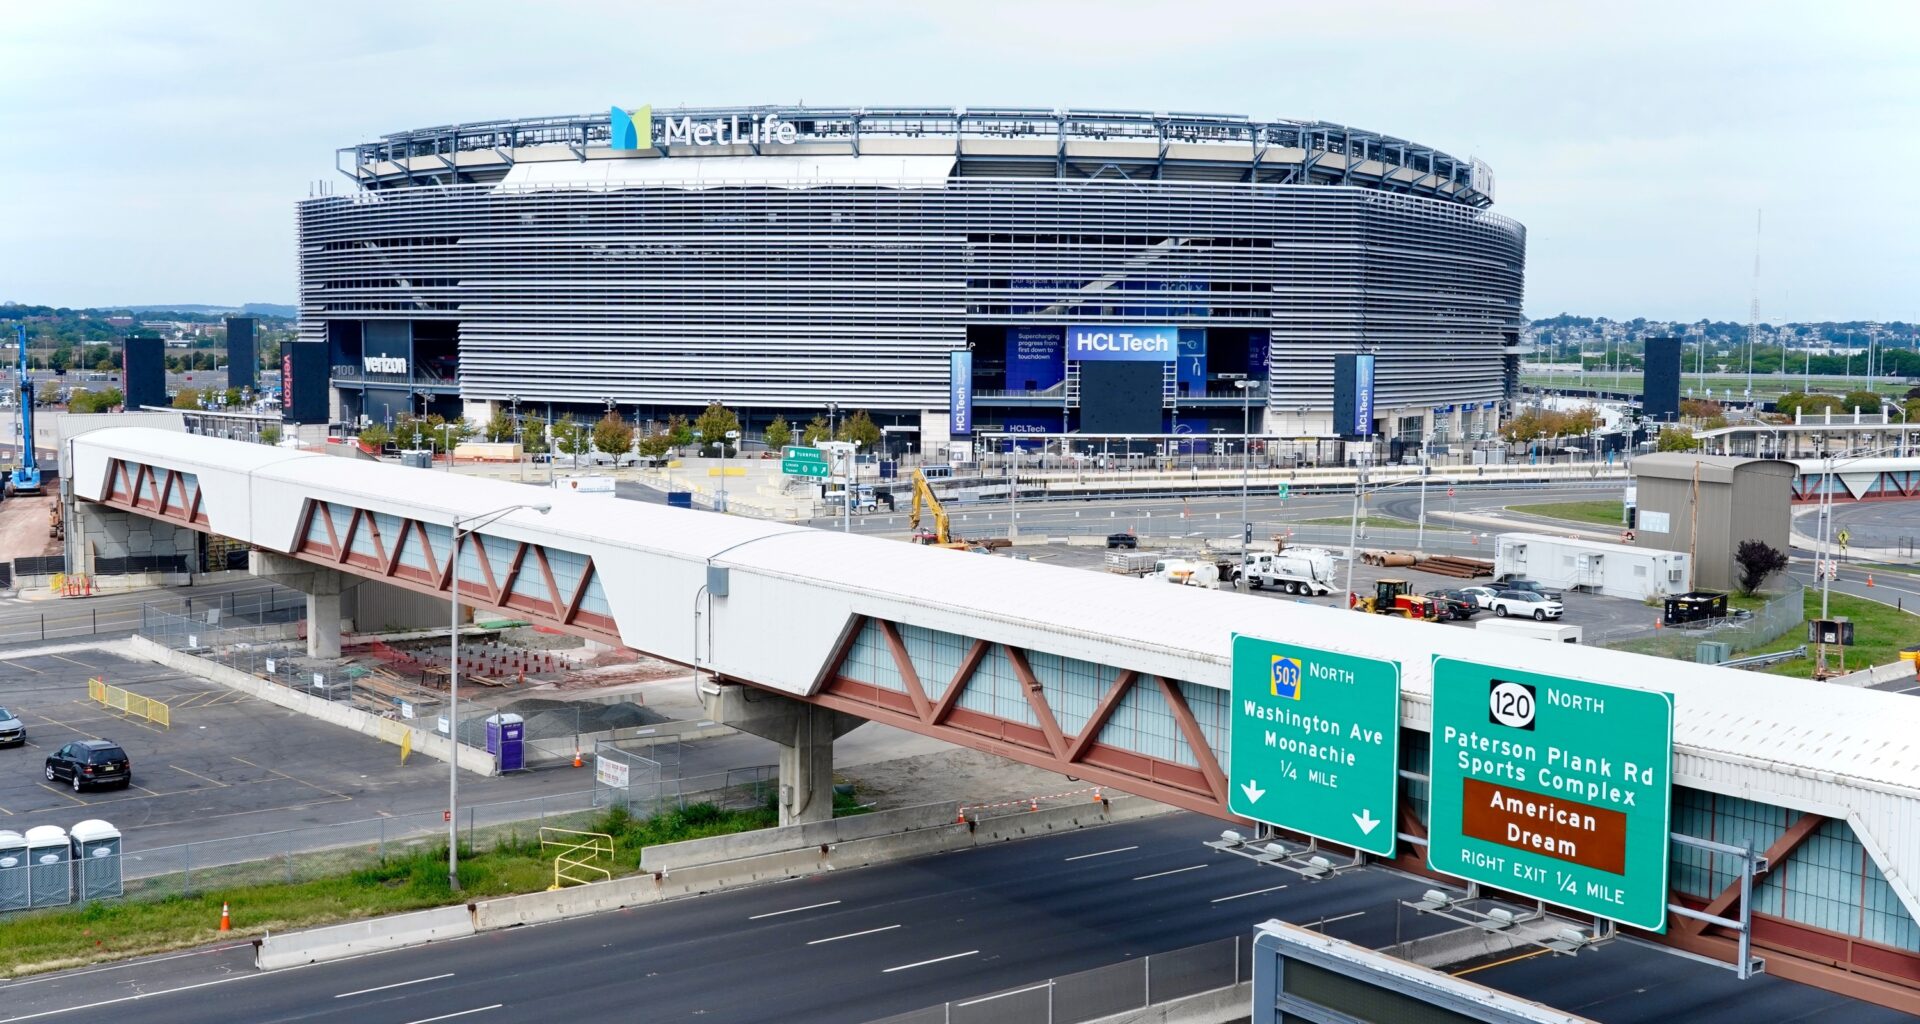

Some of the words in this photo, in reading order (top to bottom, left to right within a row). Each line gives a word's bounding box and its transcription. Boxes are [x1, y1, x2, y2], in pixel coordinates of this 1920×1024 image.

[664, 113, 797, 146] MetLife
[1018, 333, 1060, 341] Supercharging
[1077, 333, 1169, 352] HCLTech
[336, 365, 355, 376] 100
[364, 352, 407, 374] verizon
[283, 354, 292, 408] verizon
[956, 387, 966, 431] HCLTech
[1359, 389, 1369, 432] HCLTech
[1009, 425, 1046, 433] HCLTech
[1275, 665, 1297, 687] 503
[1309, 661, 1354, 685] NORTH
[1495, 691, 1530, 719] 120
[1547, 688, 1604, 714] NORTH
[1244, 699, 1340, 735] Washington
[1350, 723, 1383, 745] Ave
[1265, 730, 1356, 767] Moonachie
[1444, 725, 1536, 762] Paterson
[1547, 746, 1611, 778] Plank
[1624, 761, 1653, 786] Rd
[1308, 769, 1338, 788] MILE
[1458, 750, 1526, 782] Sports
[1538, 768, 1636, 807] Complex
[1490, 790, 1596, 832] American
[1507, 823, 1576, 857] Dream
[1461, 848, 1505, 872] RIGHT
[1513, 863, 1547, 884] EXIT
[1586, 881, 1625, 905] MILE
